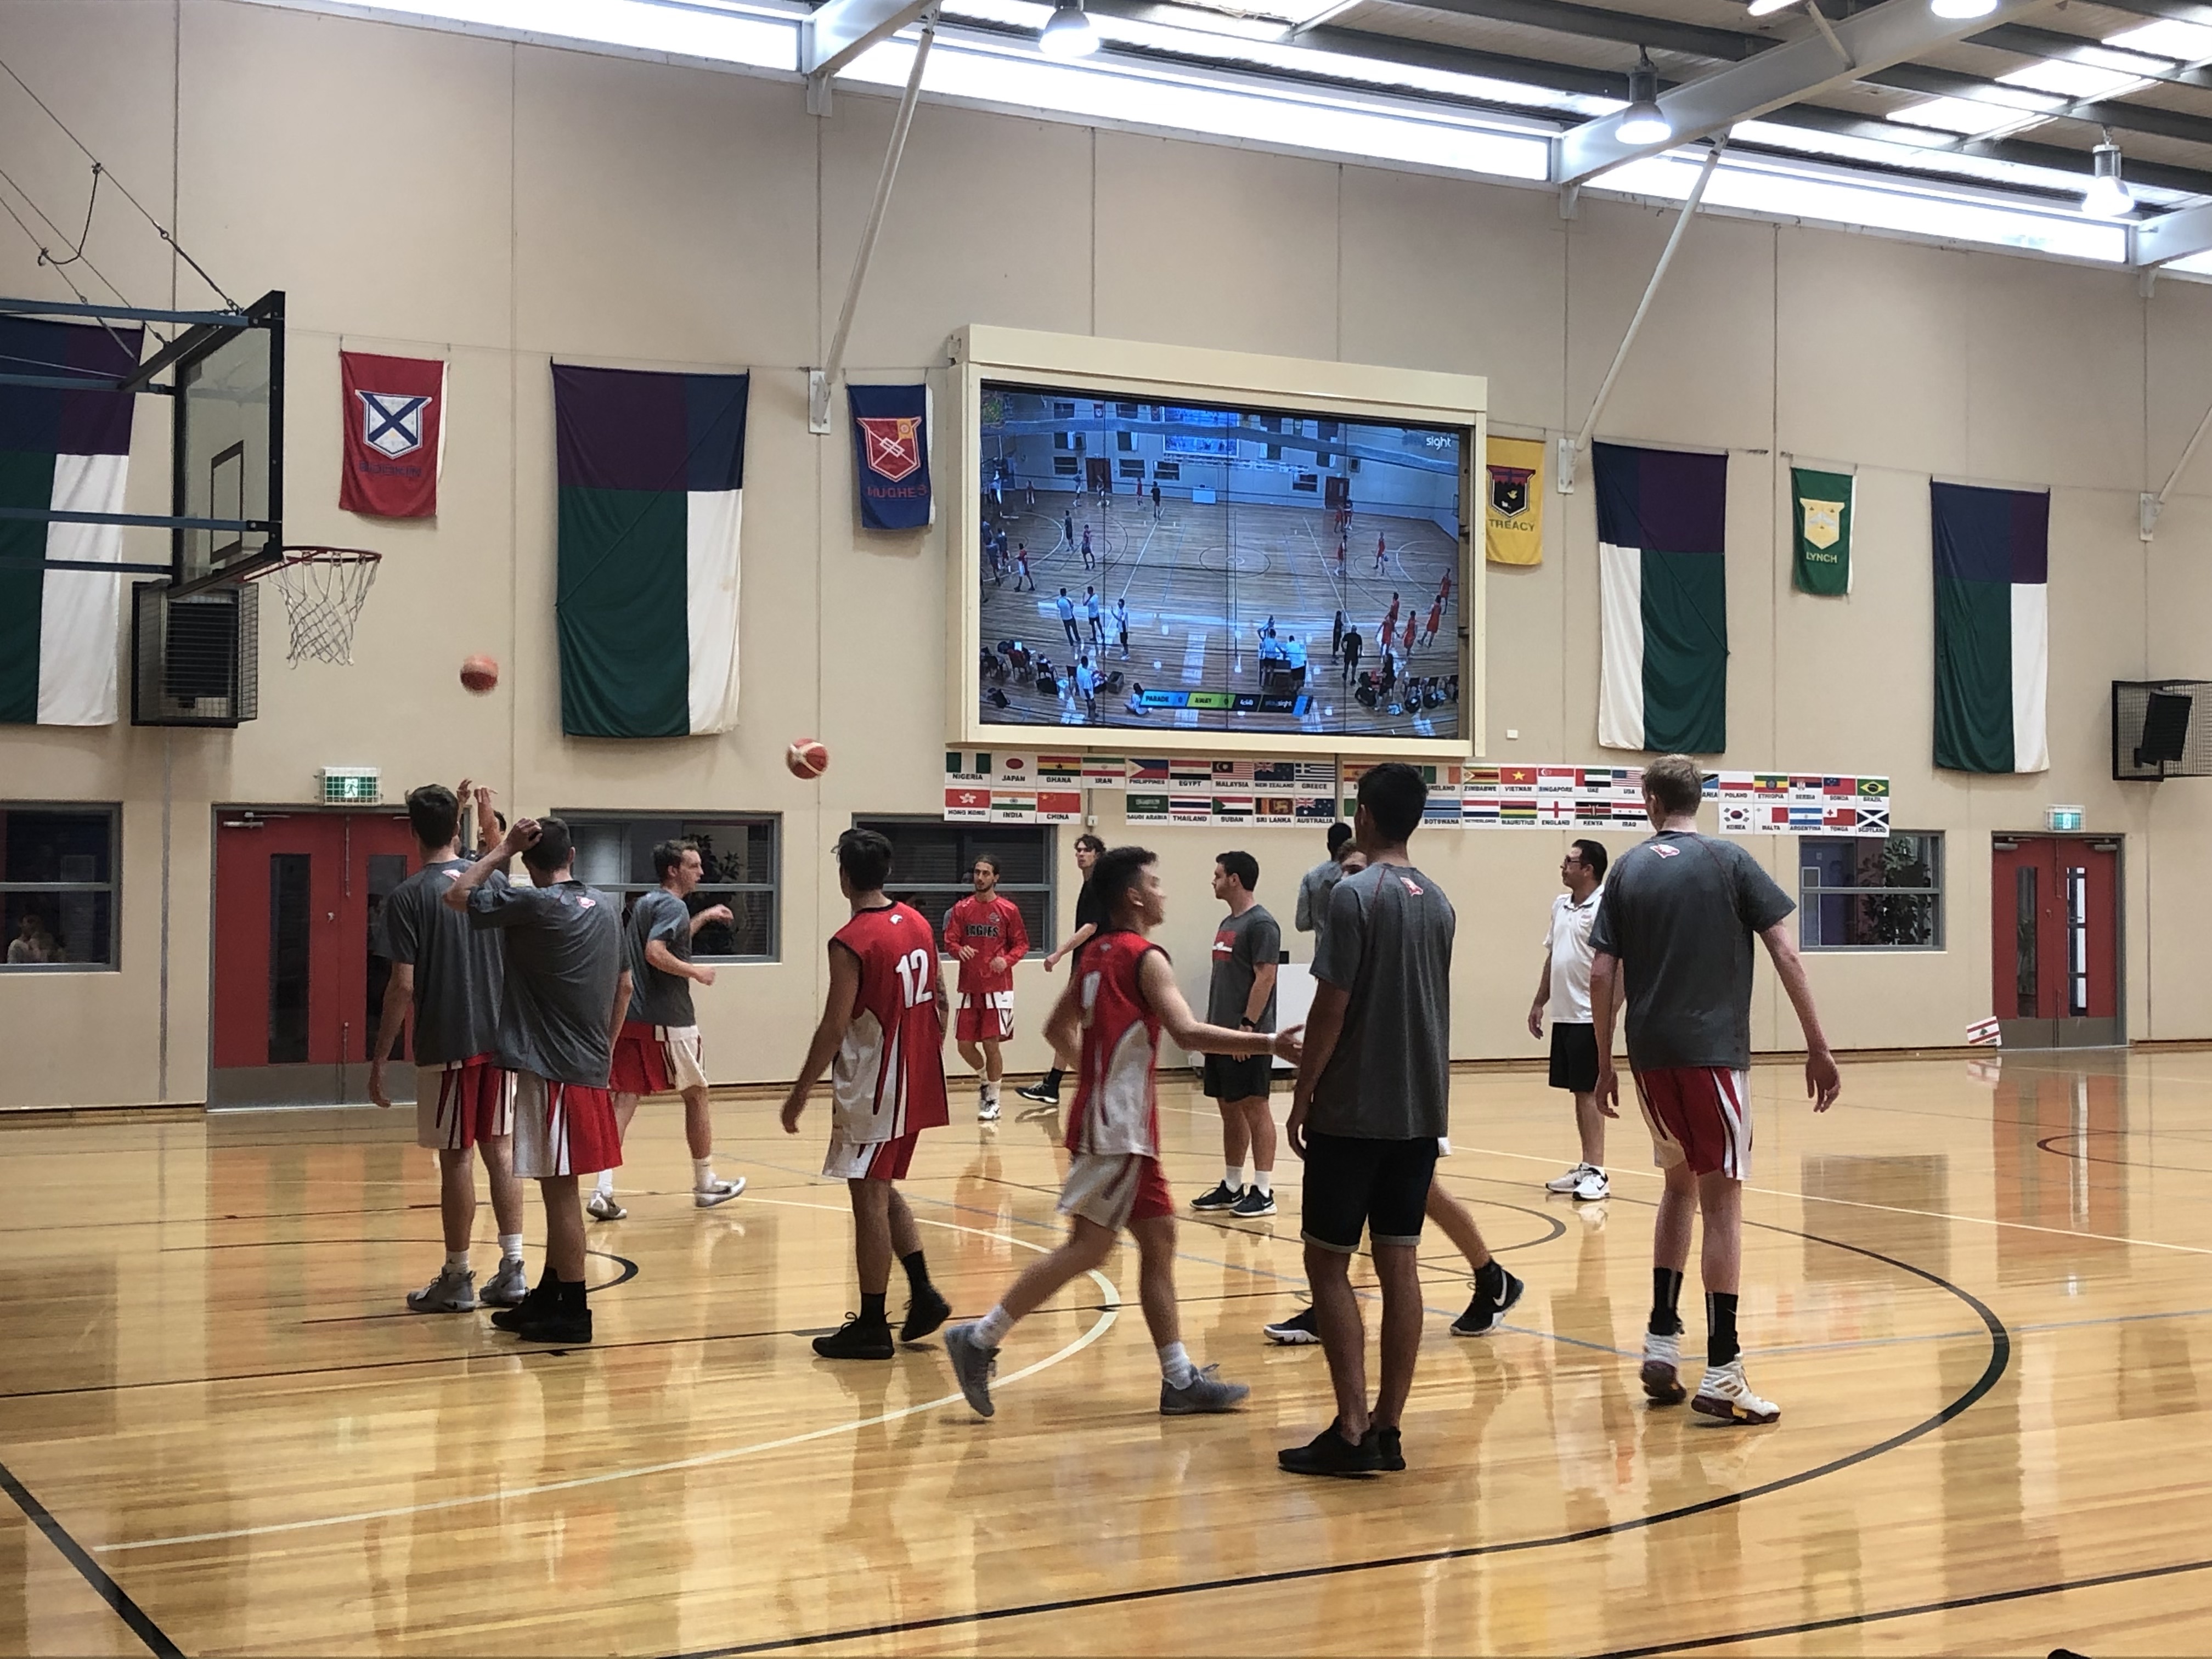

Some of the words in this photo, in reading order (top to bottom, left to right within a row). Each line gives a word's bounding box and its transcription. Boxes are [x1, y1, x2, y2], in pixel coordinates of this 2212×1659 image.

[867, 484, 927, 499] HUGHES
[1488, 518, 1535, 532] TREACY
[1806, 551, 1838, 563] LYNCH
[895, 948, 933, 1009] 12
